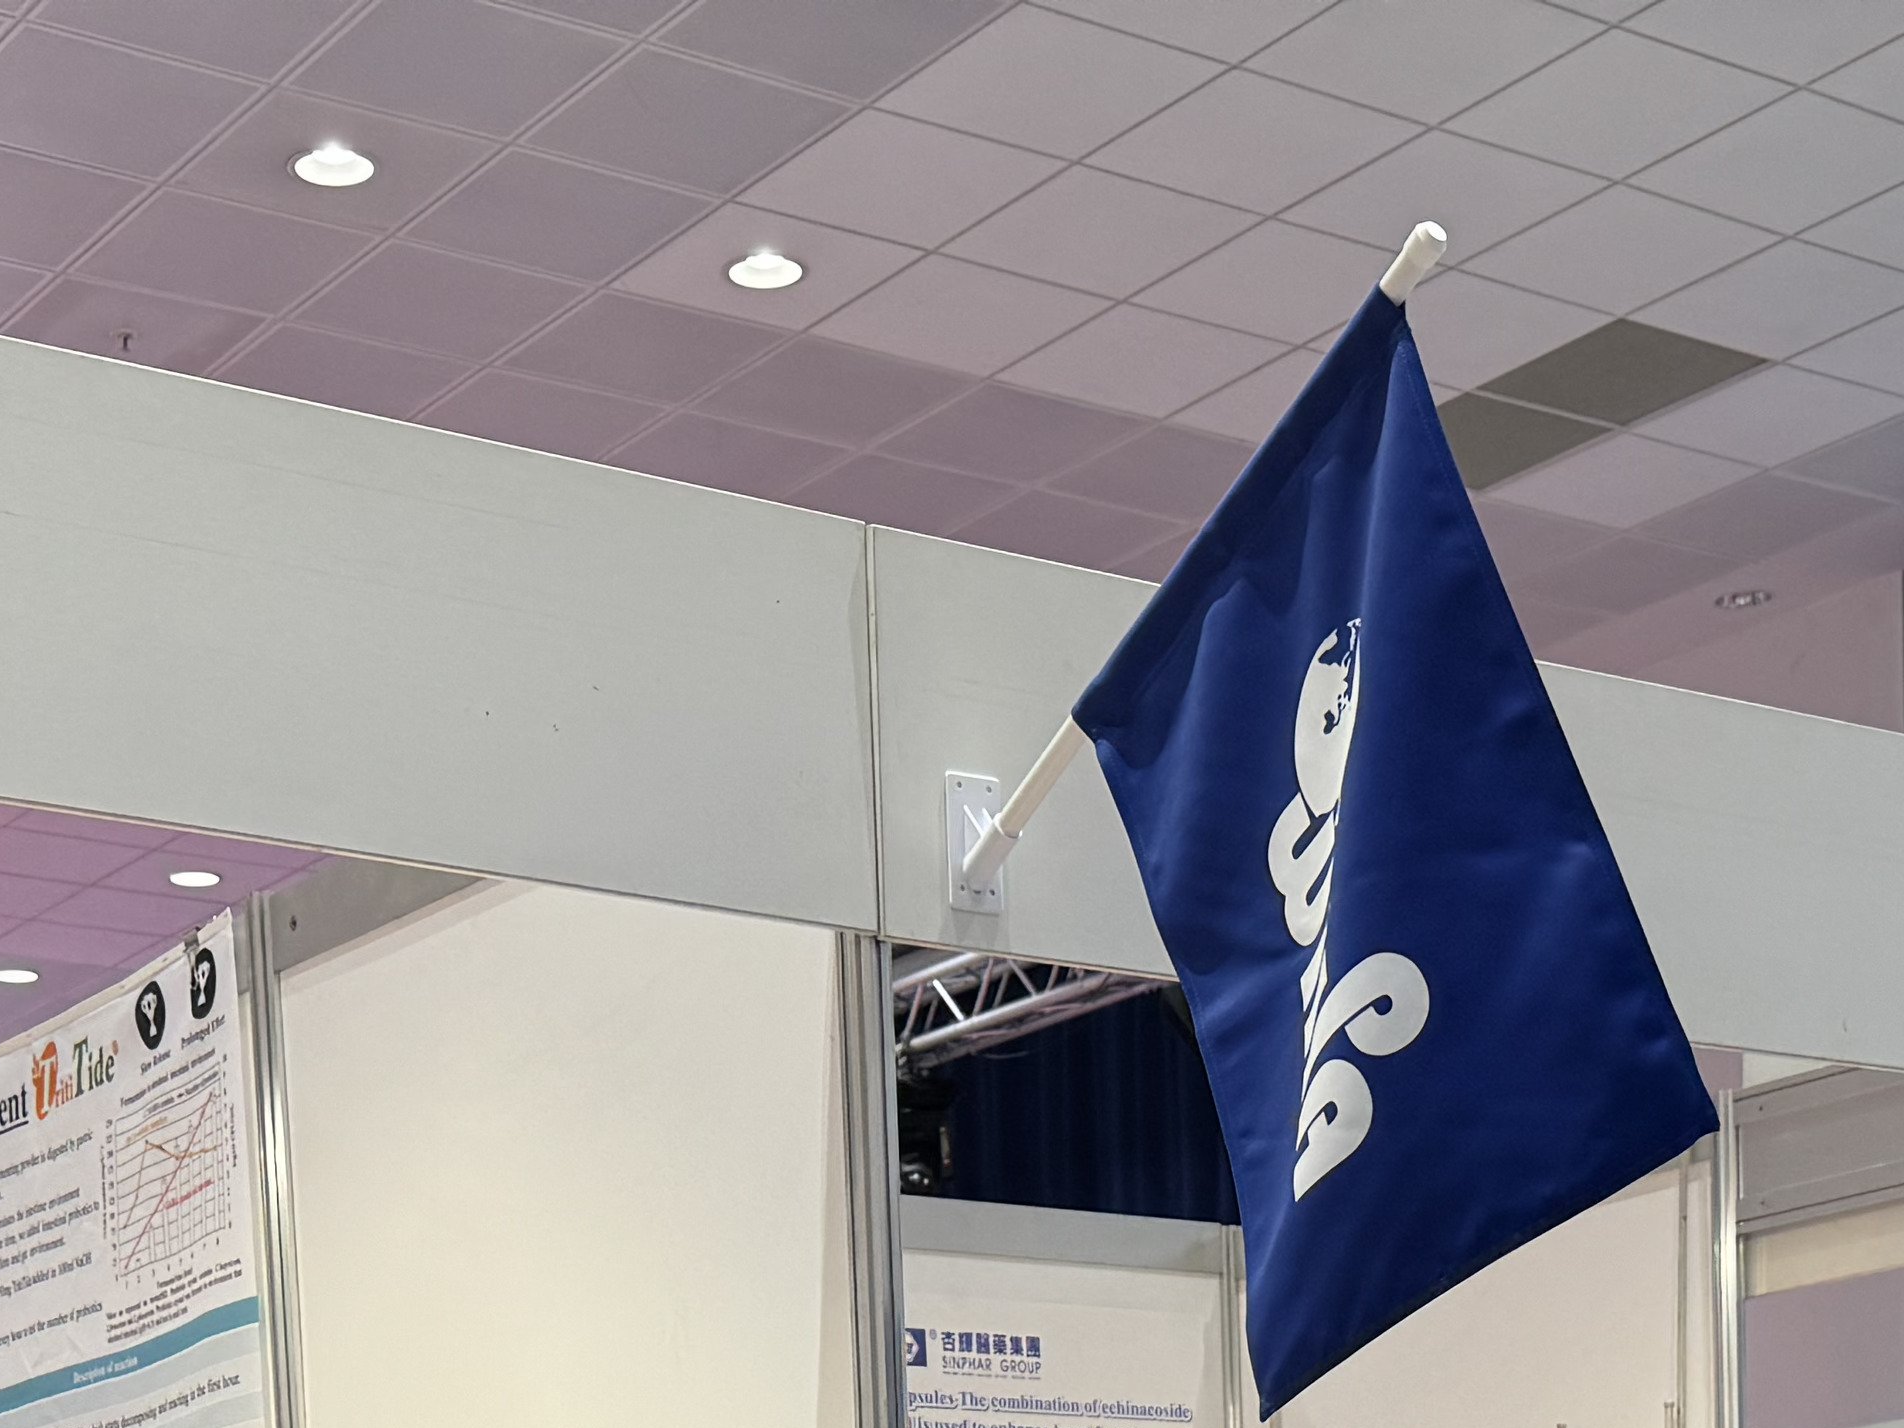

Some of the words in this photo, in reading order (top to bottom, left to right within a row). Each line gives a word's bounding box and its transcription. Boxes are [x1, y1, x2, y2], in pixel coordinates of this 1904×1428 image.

[1000, 1359, 1041, 1374] GROUP
[991, 1396, 1079, 1415] combination
[1102, 1400, 1191, 1419] echinacoside
